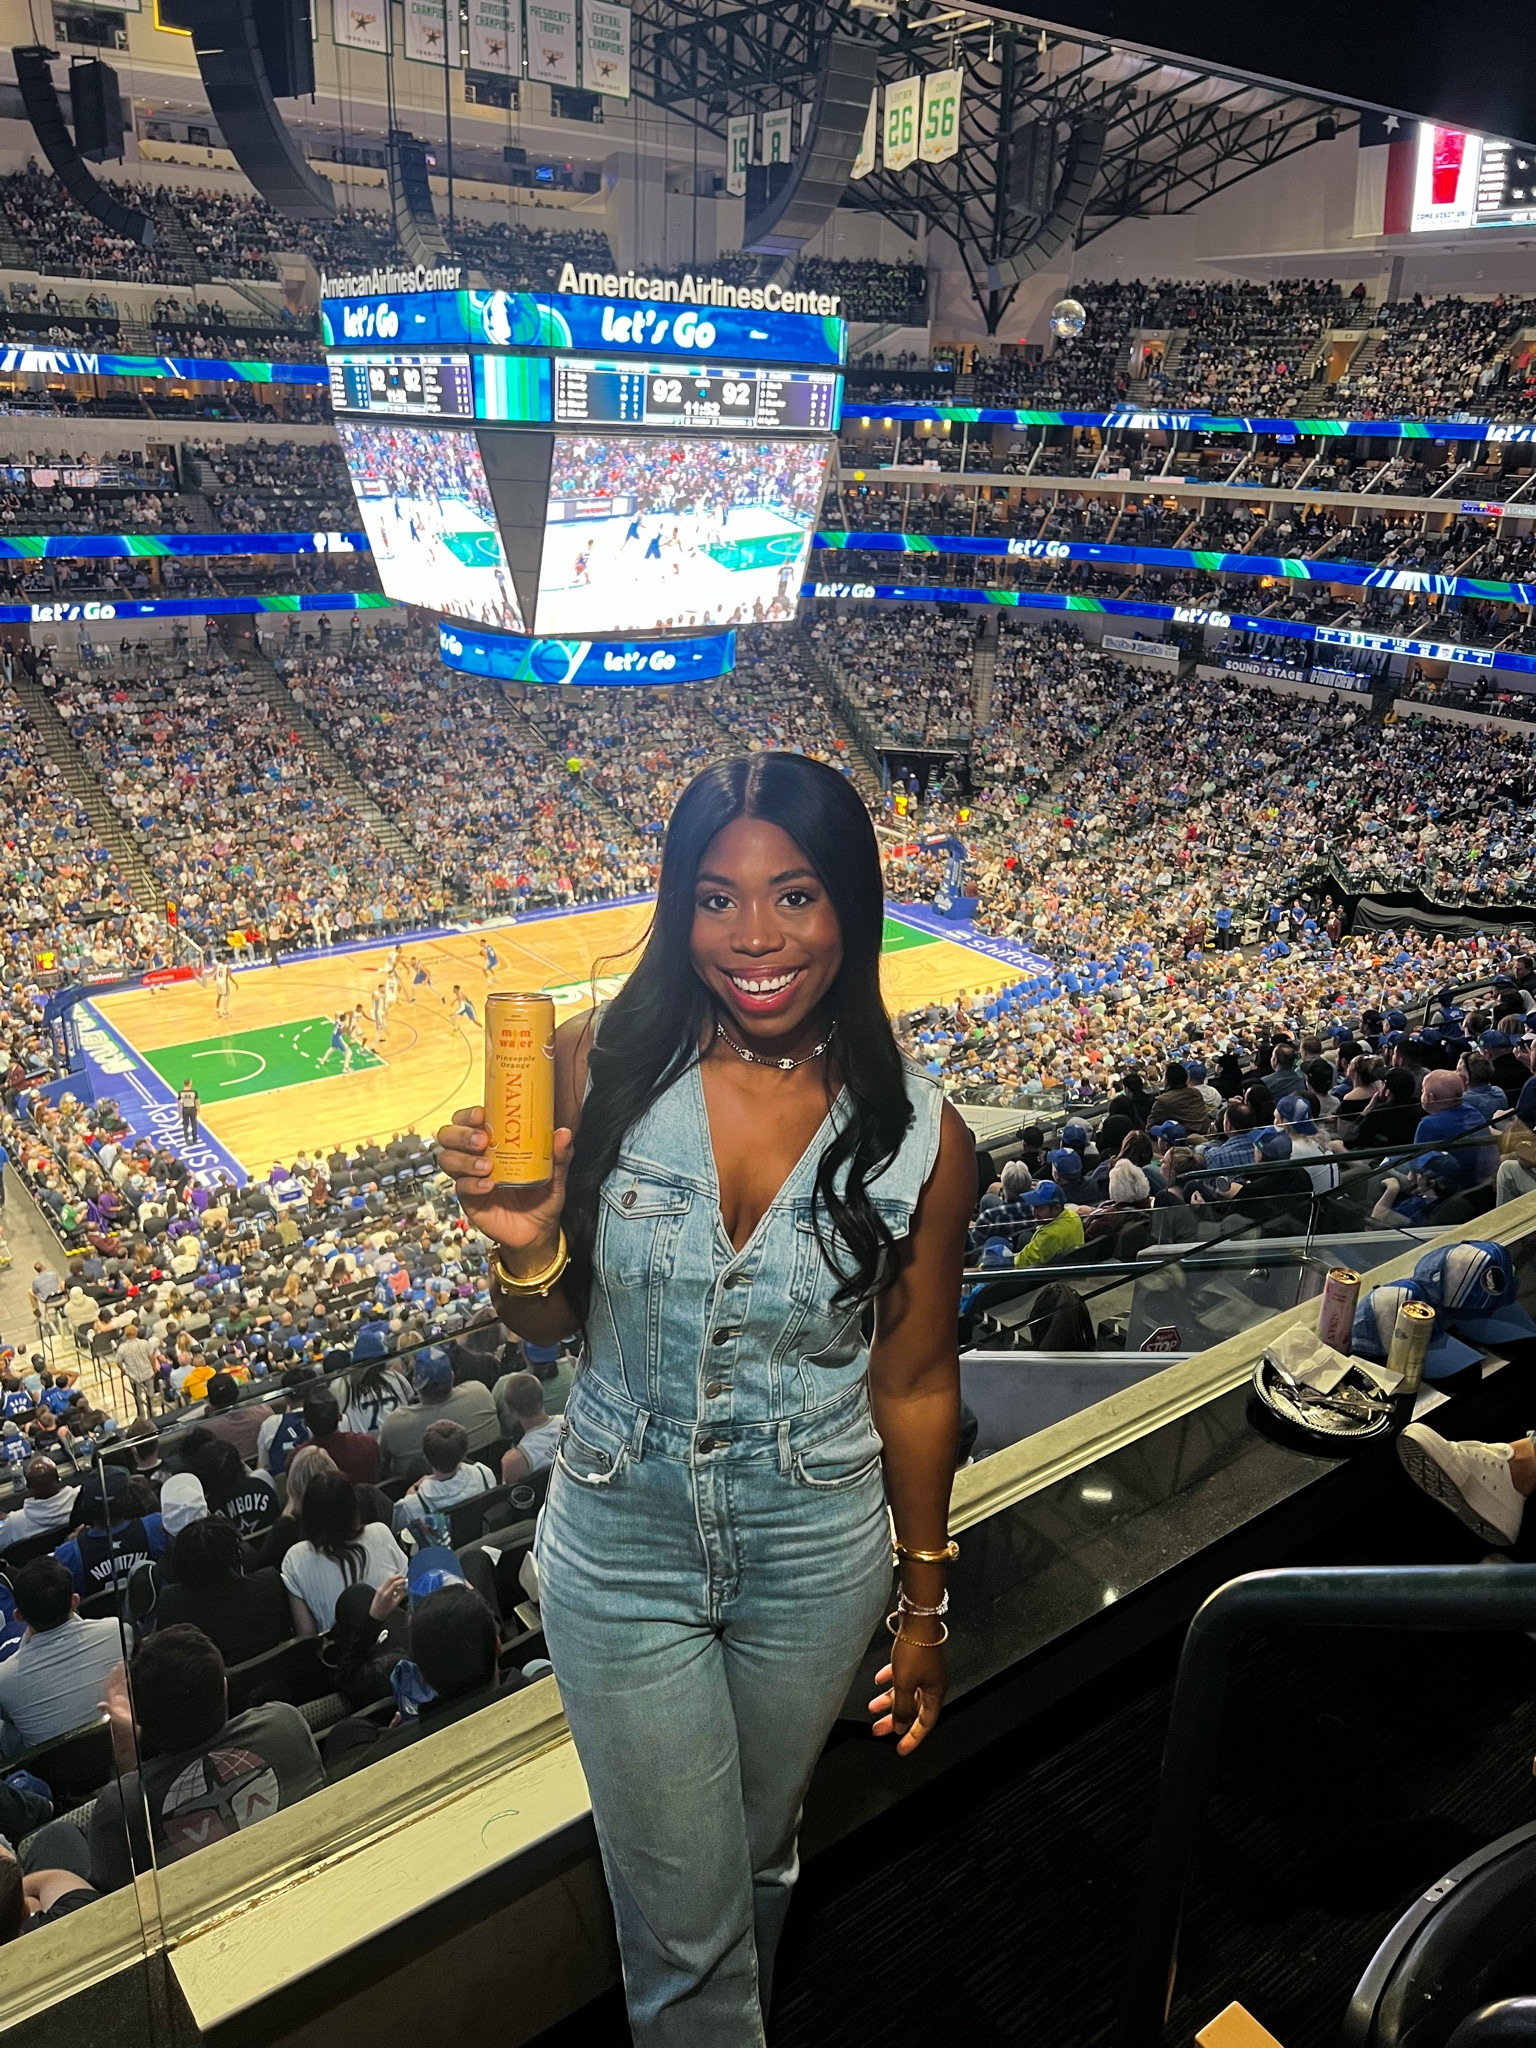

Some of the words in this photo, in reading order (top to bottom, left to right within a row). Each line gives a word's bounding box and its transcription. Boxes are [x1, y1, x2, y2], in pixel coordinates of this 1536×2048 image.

[589, 38, 625, 55] CHAMPIONS
[888, 105, 913, 147] 26
[925, 96, 956, 139] 56
[557, 262, 841, 315] AmericanAirlinesCenter
[343, 305, 375, 338] Let's
[375, 302, 399, 338] Go
[601, 306, 669, 344] Let's
[673, 311, 716, 348] Go
[653, 378, 682, 403] 92
[722, 381, 750, 405] 92
[683, 400, 720, 417] 11:52
[1007, 538, 1045, 556] Let's
[1045, 541, 1070, 557] Go
[815, 582, 850, 598] Let's
[851, 584, 876, 598] Go
[32, 603, 80, 622] Let's
[83, 602, 116, 620] Go
[1173, 606, 1208, 624] Let's
[1209, 611, 1231, 628] Go
[603, 651, 647, 671] Let's
[650, 650, 676, 671] Go
[1225, 660, 1260, 674] SOUND
[1266, 667, 1304, 682] STAGE
[496, 1054, 536, 1062] Pineapple
[500, 1061, 530, 1069] Orange
[505, 1072, 522, 1148] NANCY
[1146, 1340, 1178, 1352] STOP
[215, 1493, 269, 1519] OWBOYS
